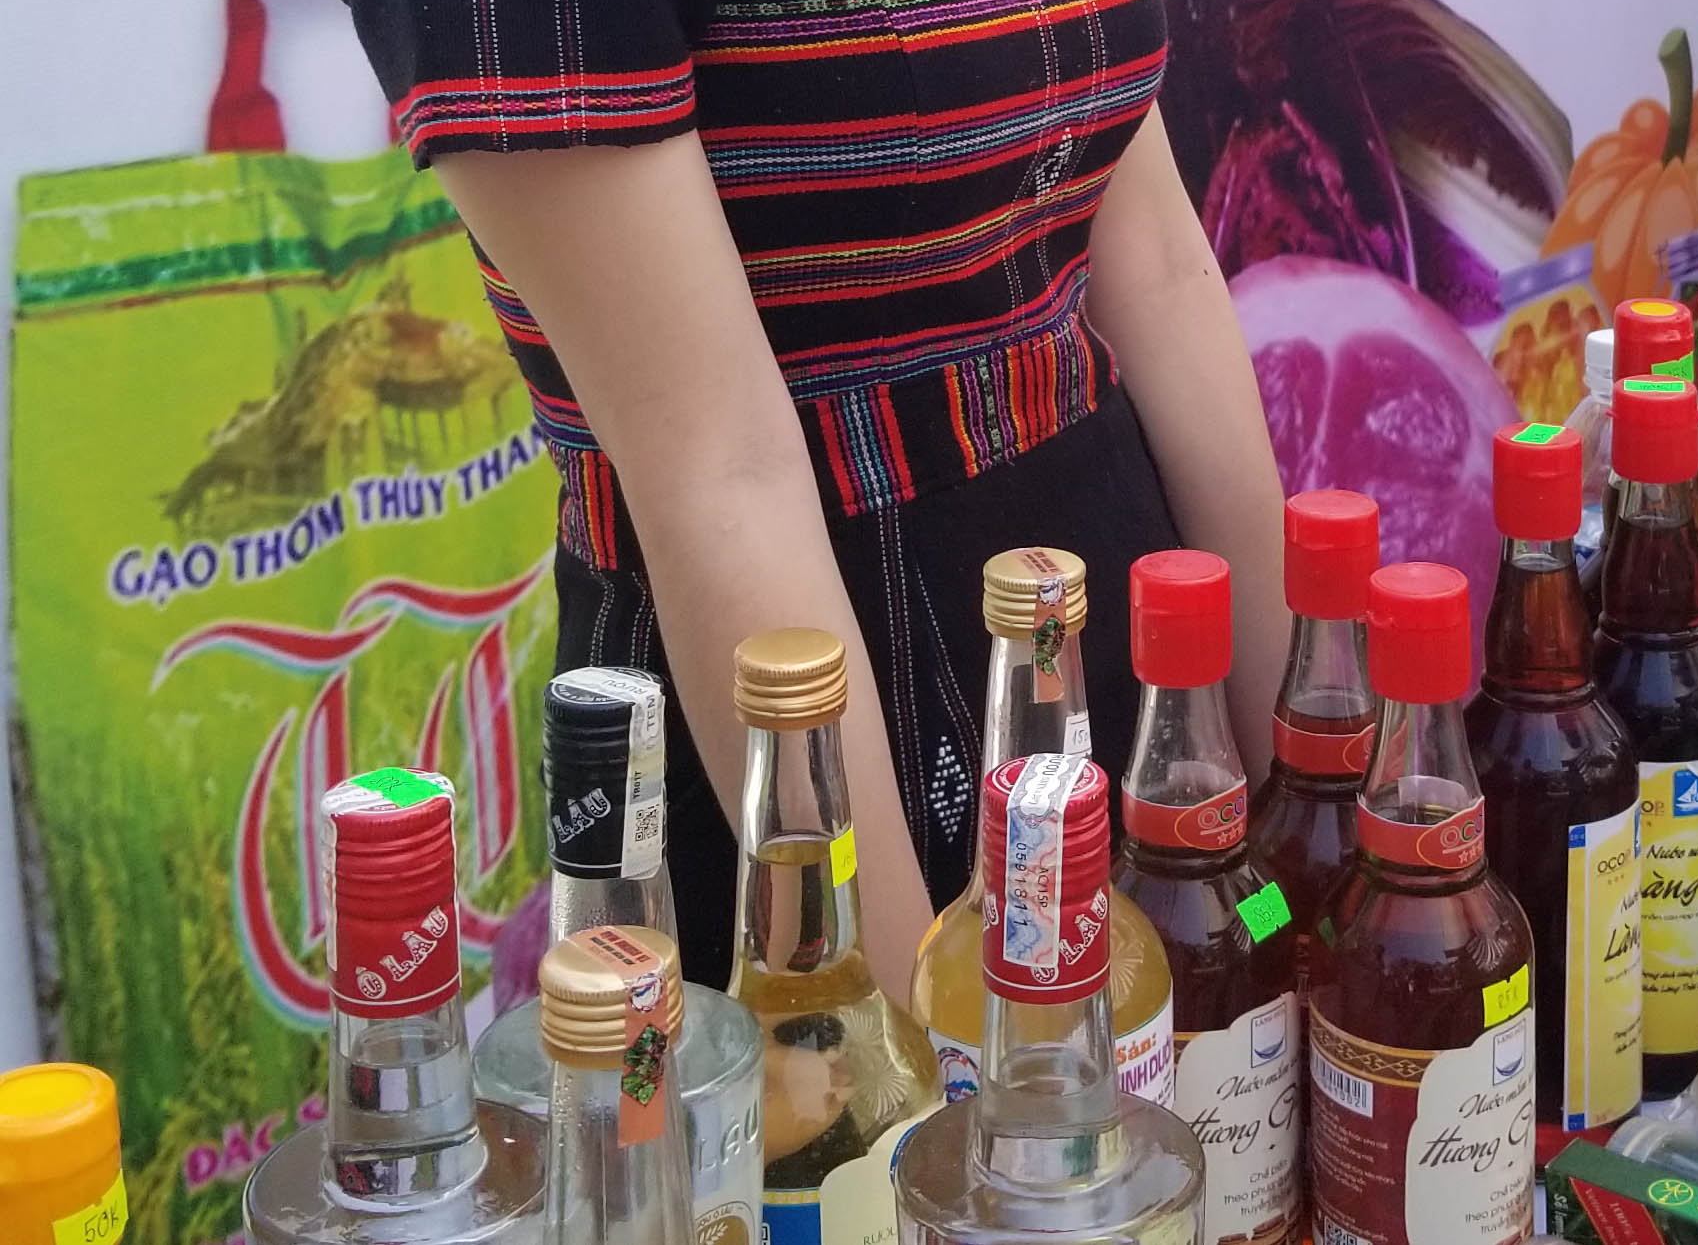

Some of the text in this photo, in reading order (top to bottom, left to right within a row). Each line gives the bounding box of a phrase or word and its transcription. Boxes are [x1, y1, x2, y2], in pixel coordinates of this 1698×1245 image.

[113, 544, 218, 605] GẠO
[230, 493, 345, 580] THƠM
[457, 423, 548, 501] THAN
[1197, 794, 1247, 829] OCO
[1439, 812, 1484, 847] OCO
[1013, 842, 1029, 927] 0591811
[1119, 1060, 1149, 1095] INH
